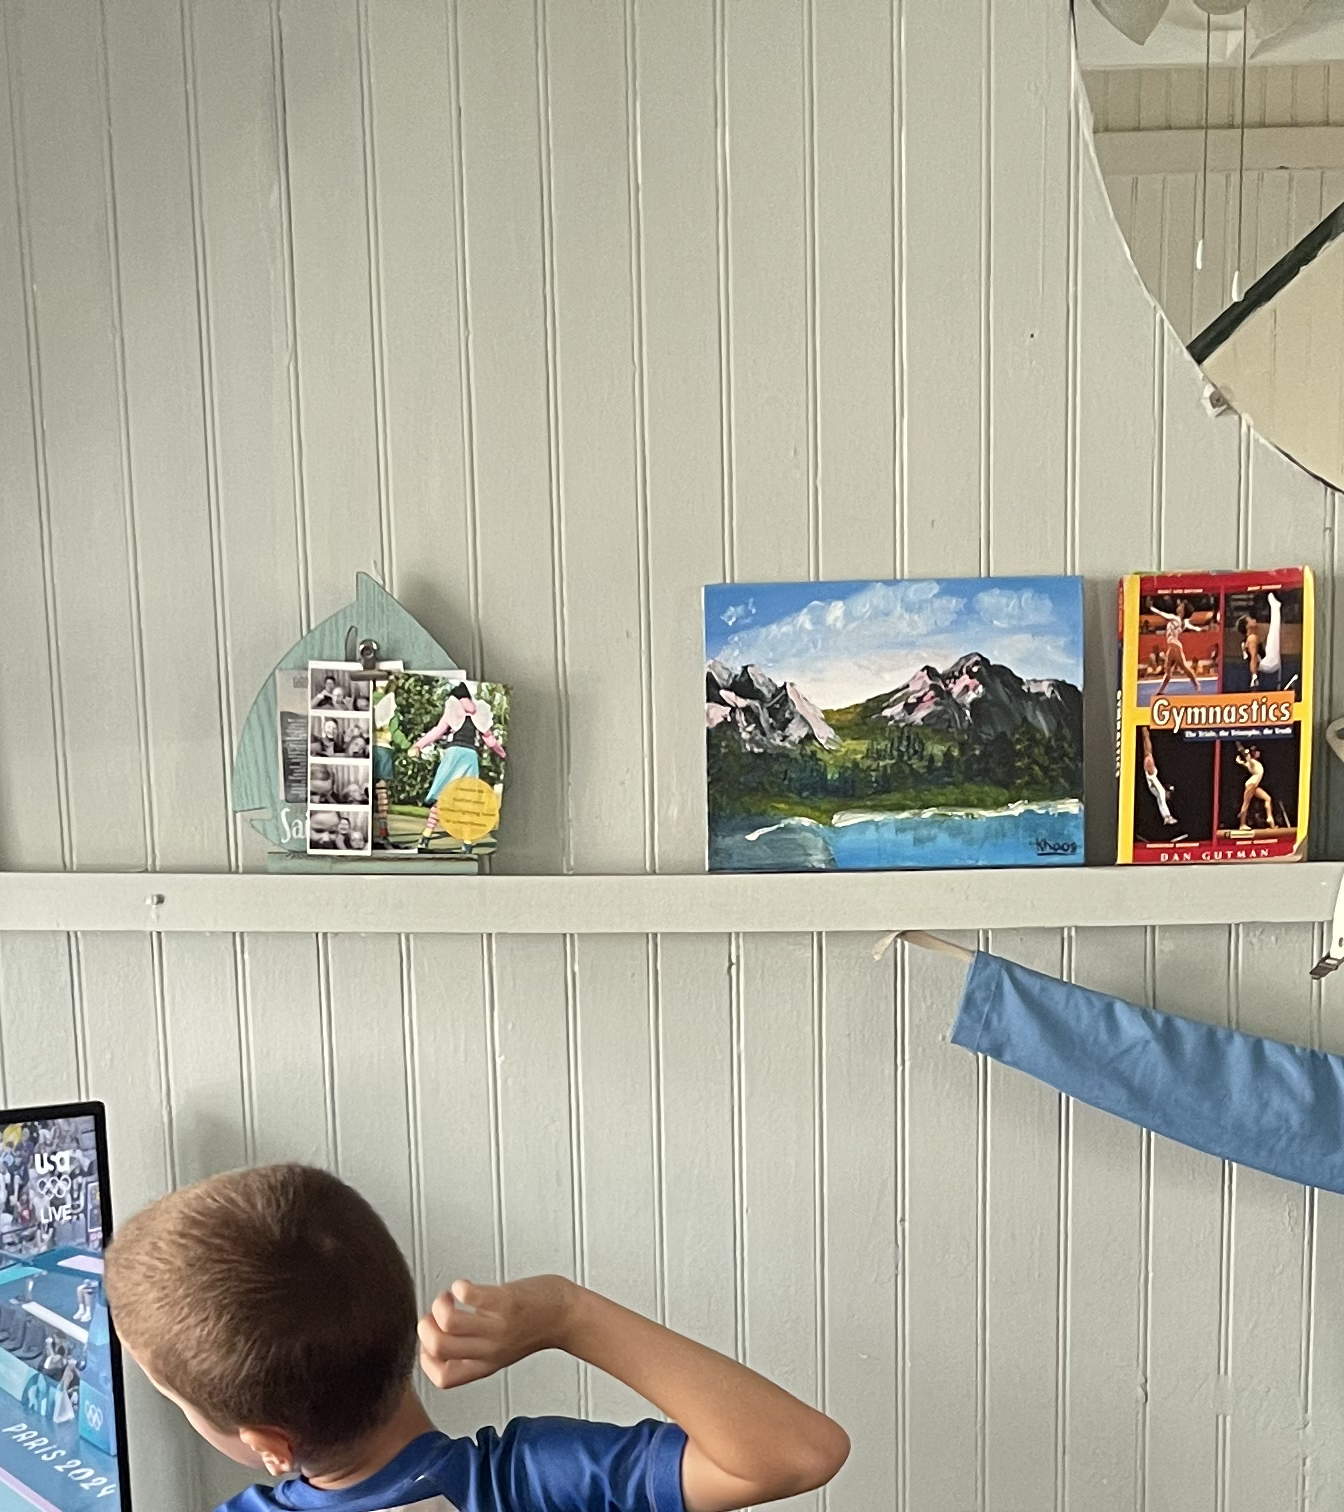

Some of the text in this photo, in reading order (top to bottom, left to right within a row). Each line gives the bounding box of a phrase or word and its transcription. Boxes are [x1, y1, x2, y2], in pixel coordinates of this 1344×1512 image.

[1152, 697, 1292, 734] Gymnastics
[1160, 848, 1269, 862] DAN GUTMAN
[40, 1204, 72, 1224] LIVE
[2, 1422, 117, 1498] PARIS 2024
